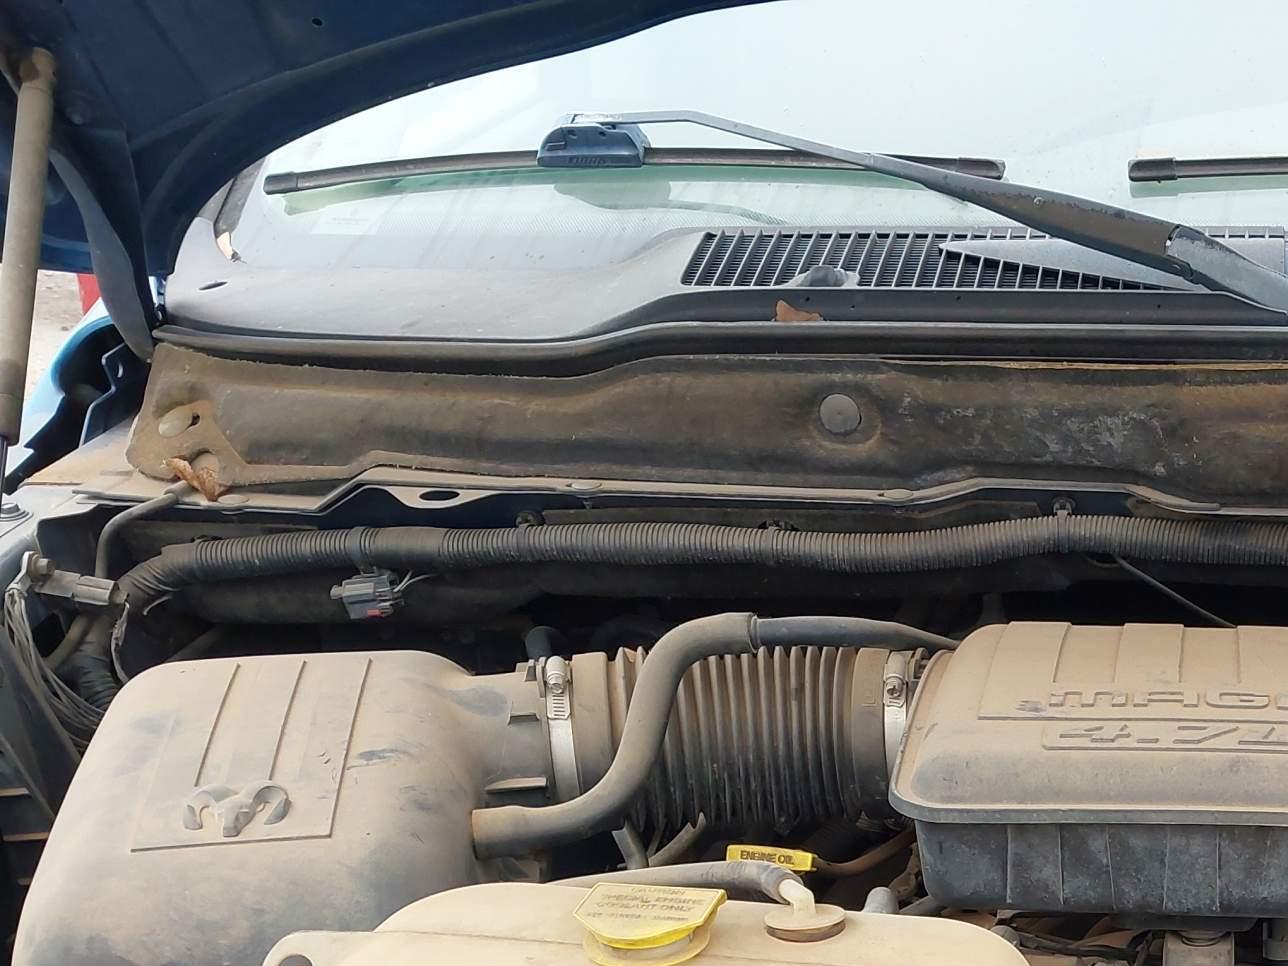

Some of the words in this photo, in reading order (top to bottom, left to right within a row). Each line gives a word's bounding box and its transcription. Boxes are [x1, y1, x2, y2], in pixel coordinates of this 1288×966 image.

[740, 849, 777, 863] ENGINE
[777, 854, 795, 865] OIL
[661, 903, 696, 913] ONLY
